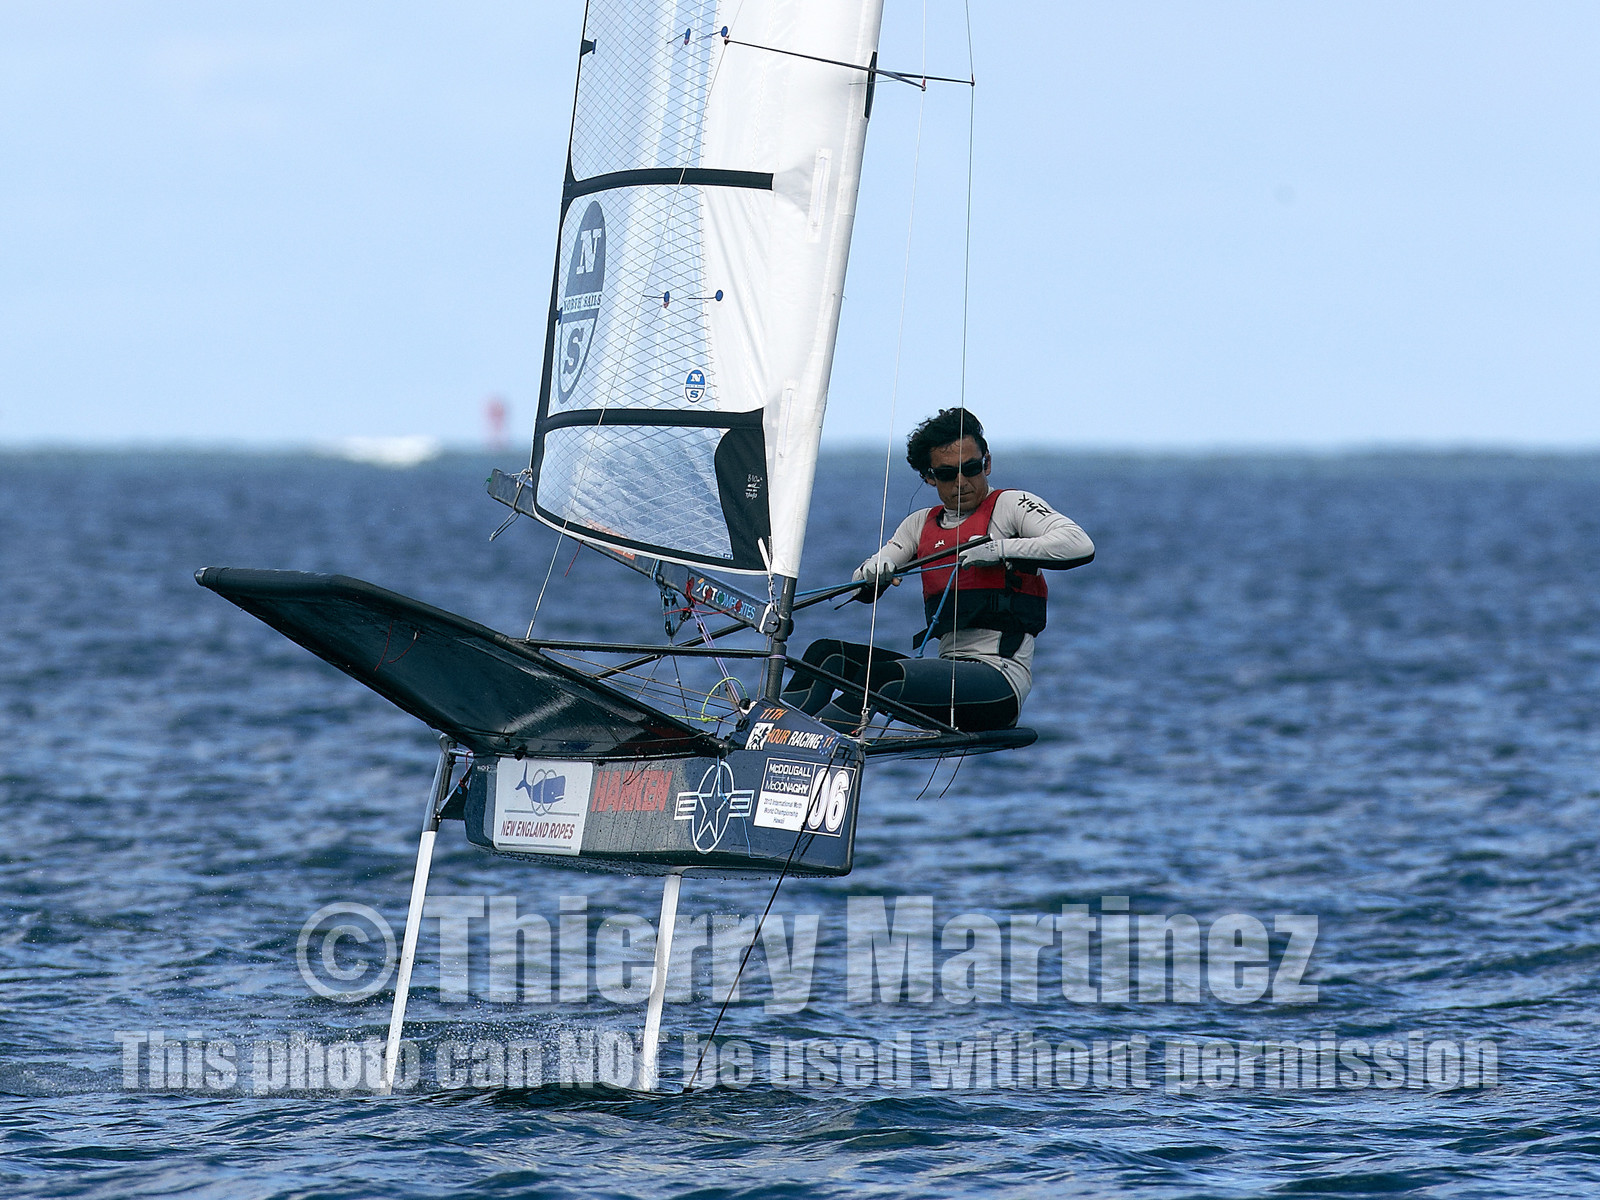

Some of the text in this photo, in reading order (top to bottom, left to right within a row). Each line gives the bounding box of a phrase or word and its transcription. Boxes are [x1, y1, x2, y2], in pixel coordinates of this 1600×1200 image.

[576, 228, 603, 275] N
[562, 328, 584, 375] S
[760, 707, 788, 720] 11TH
[767, 728, 791, 745] HOUR
[788, 731, 824, 750] RACING
[807, 767, 850, 832] 06
[500, 820, 575, 840] NEW ENGLAND ROPES
